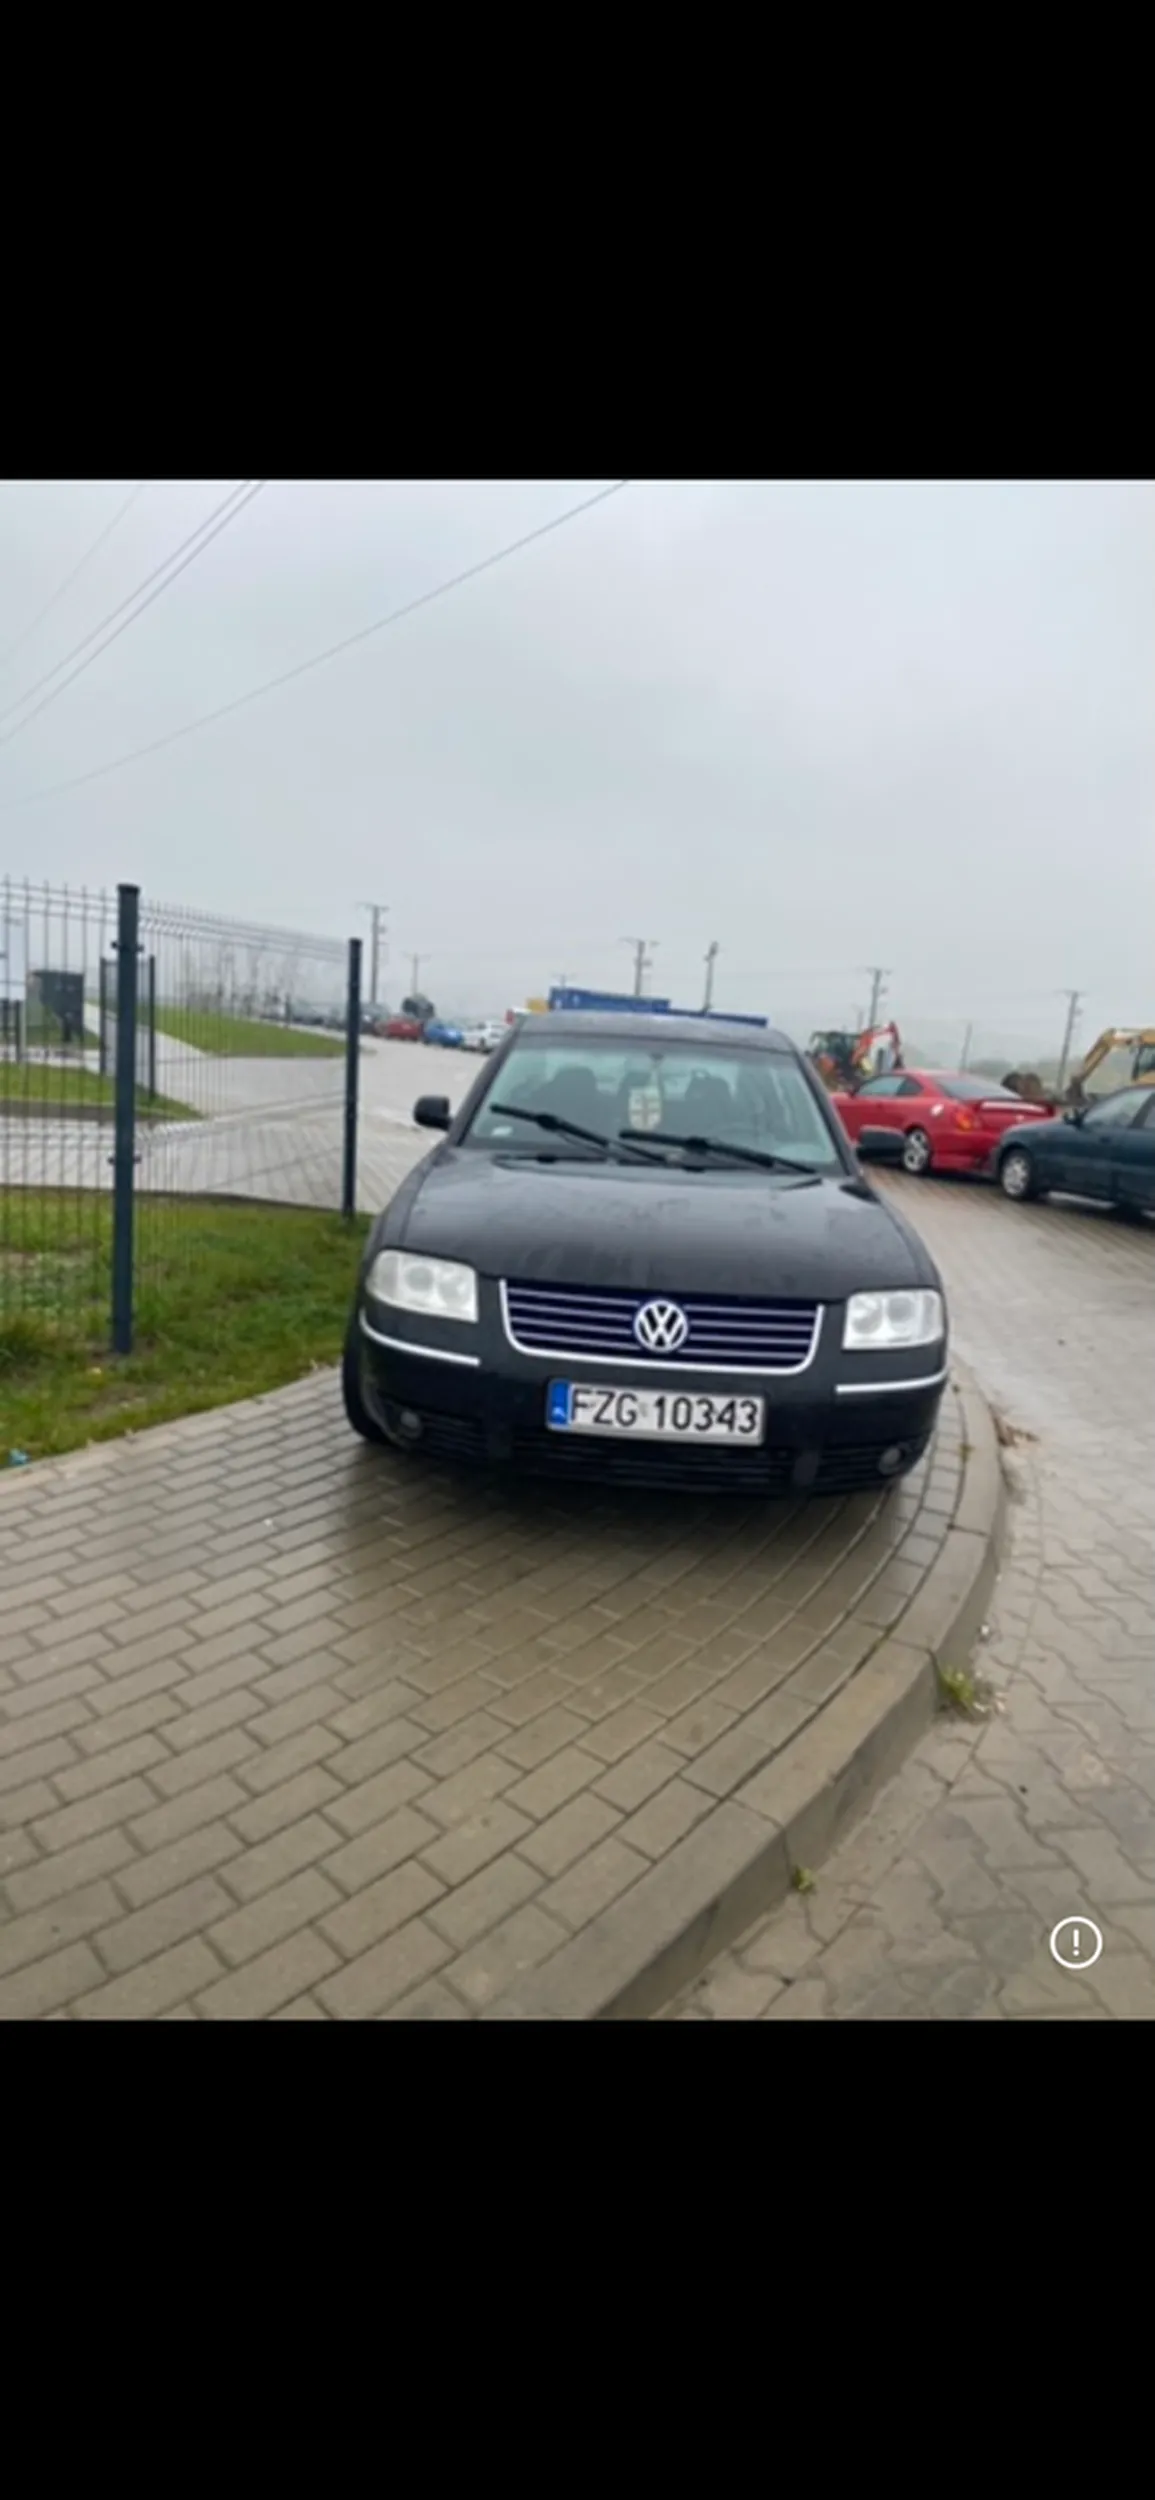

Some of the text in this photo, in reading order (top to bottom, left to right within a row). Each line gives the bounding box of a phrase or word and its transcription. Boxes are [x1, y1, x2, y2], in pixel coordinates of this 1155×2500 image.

[635, 1299, 687, 1352] VW
[572, 1388, 758, 1434] FZG 10343
